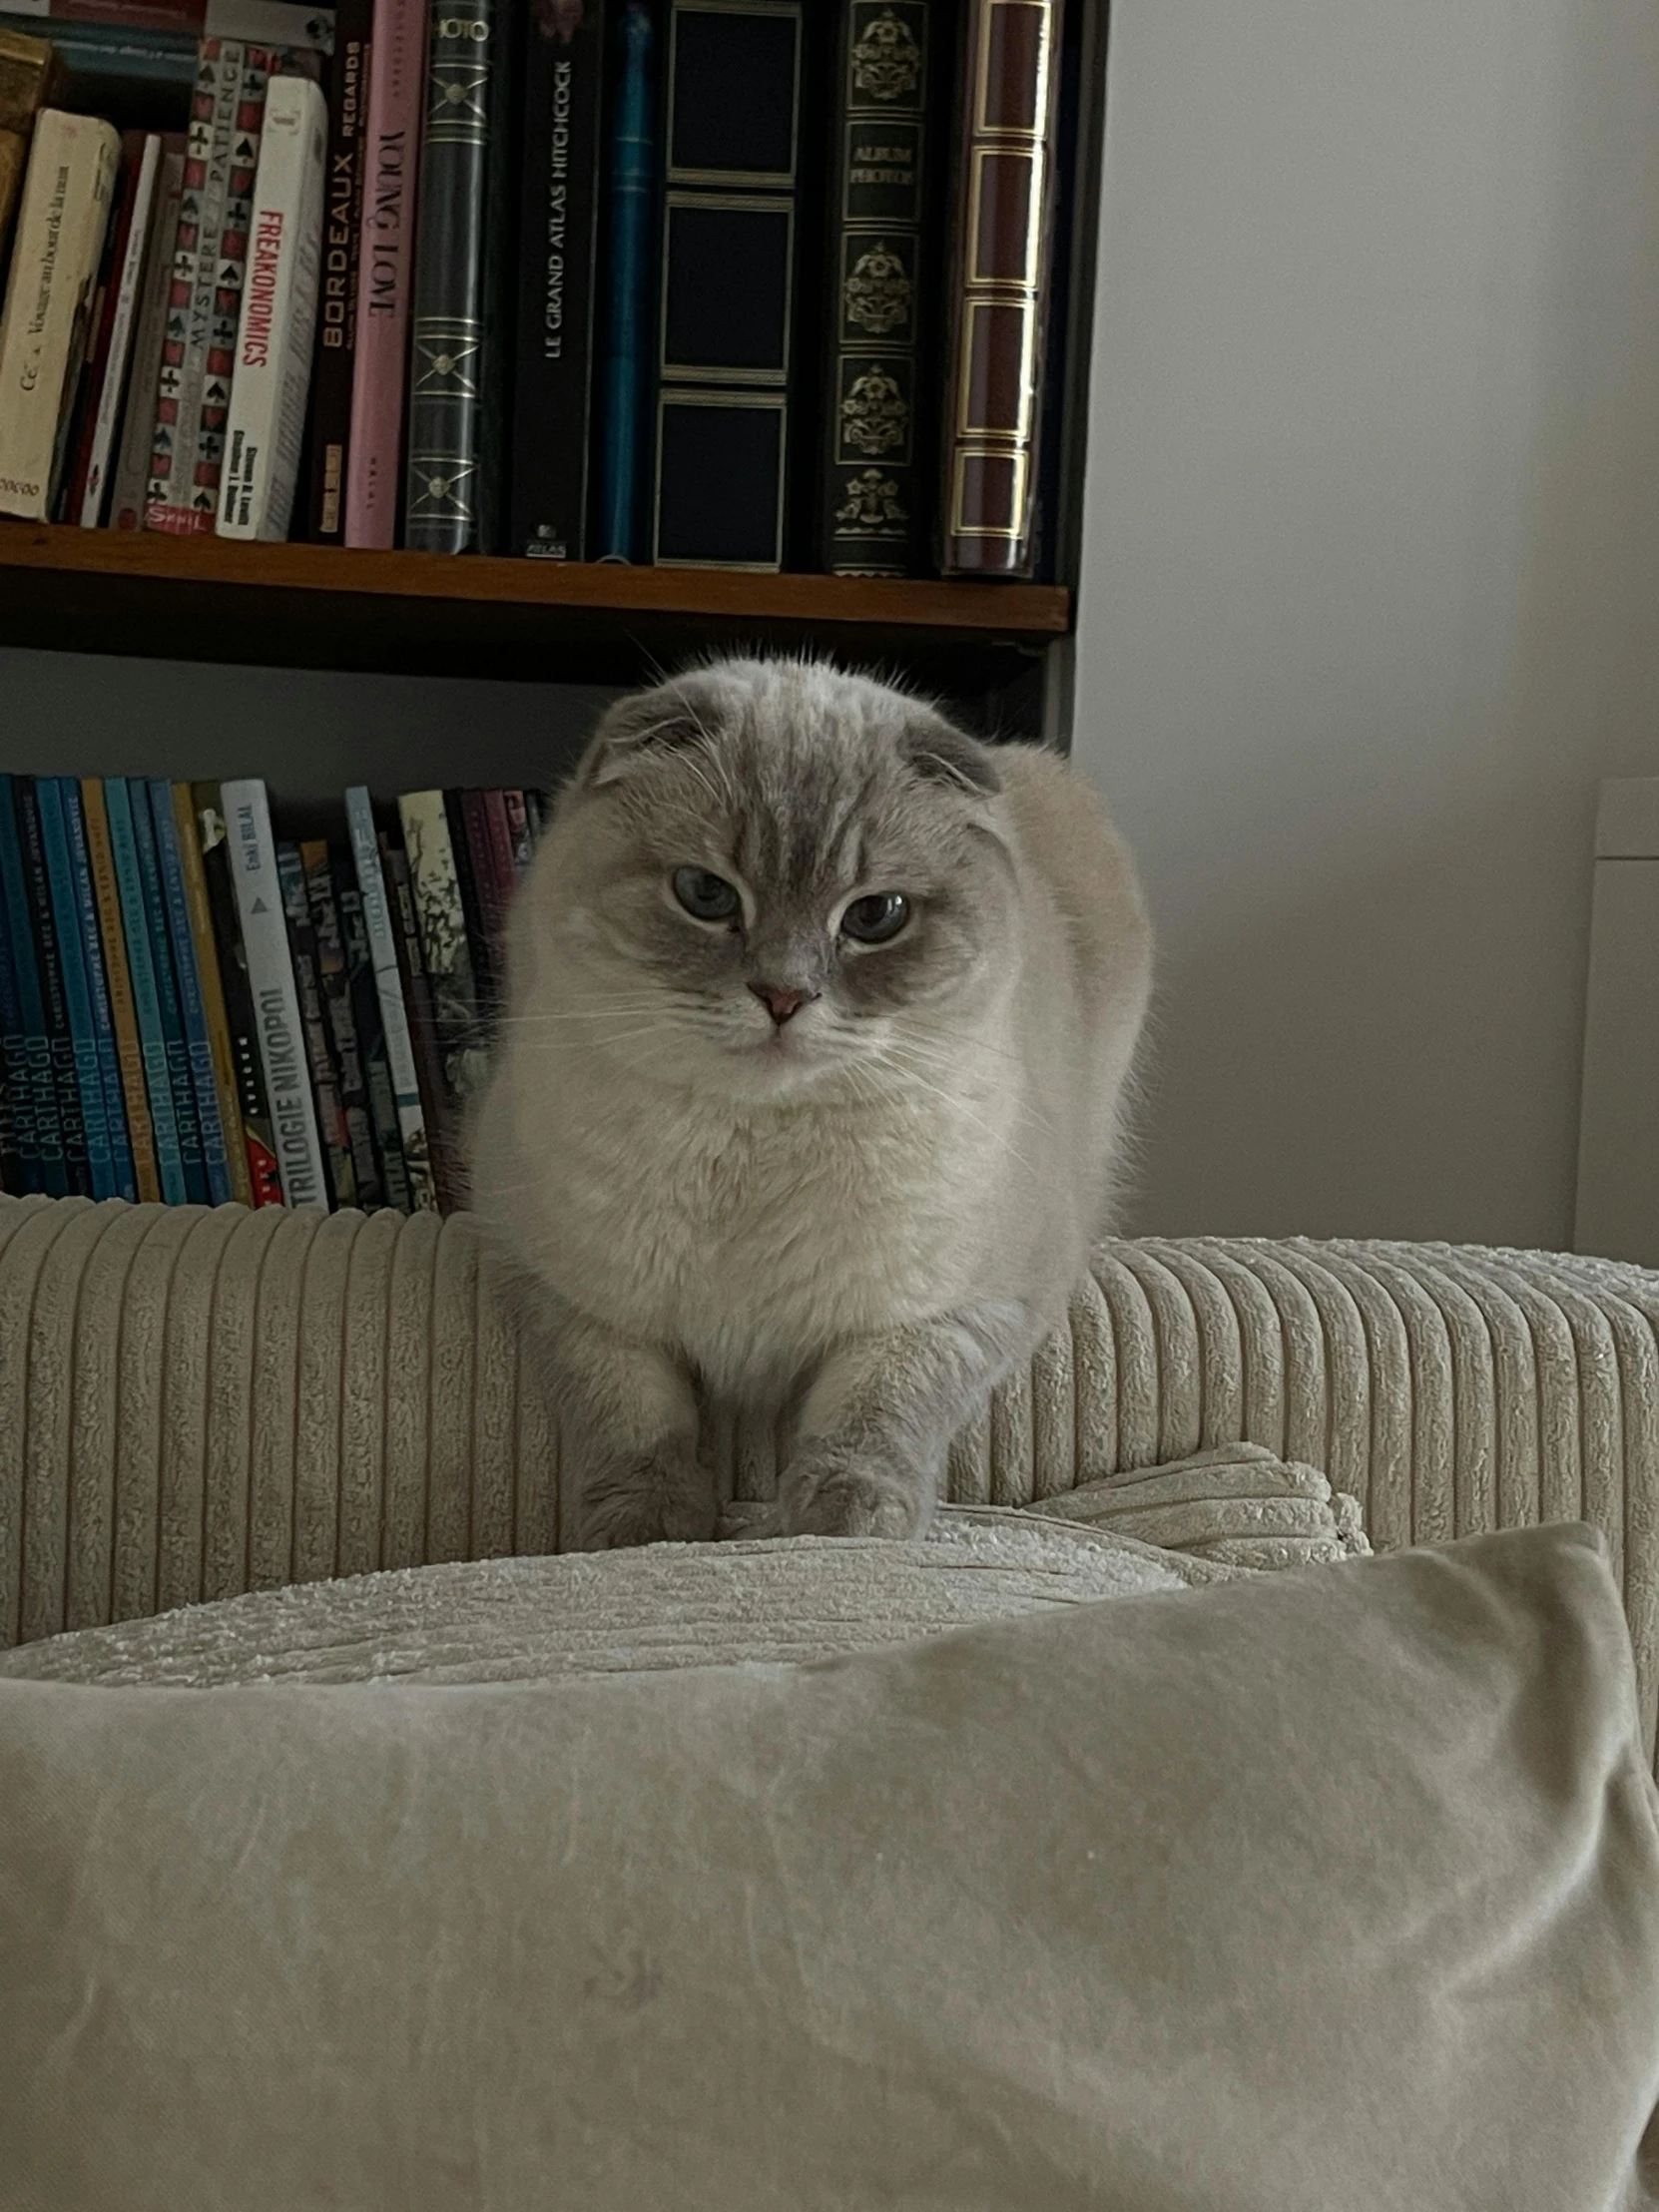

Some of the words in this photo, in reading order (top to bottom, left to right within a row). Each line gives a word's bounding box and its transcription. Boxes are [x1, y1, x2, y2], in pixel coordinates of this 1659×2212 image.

[210, 49, 242, 183] PATIENCE
[550, 60, 572, 178] HITCHCOCK
[321, 152, 357, 348] BORDEAUX
[339, 40, 361, 137] REGARDS
[367, 129, 405, 231] YOUNG
[548, 183, 568, 248] ATLAS
[242, 210, 284, 368] FREAKONOMICS
[367, 243, 398, 317] LOVE
[545, 255, 565, 329] GRAND
[544, 335, 562, 359] LE
[3, 1034, 42, 1160] CARTHAGO
[25, 1035, 63, 1161] CARTHAGO
[51, 1037, 88, 1162] CARTHAGO
[73, 1038, 111, 1163] CARTHAGO
[119, 1039, 153, 1166] CARTHAGO
[142, 1039, 180, 1167] CARTHAGO
[166, 1039, 202, 1166] CARTHAGO
[188, 1039, 228, 1166] CARTHAGO
[276, 1096, 318, 1209] TRILOGIE
